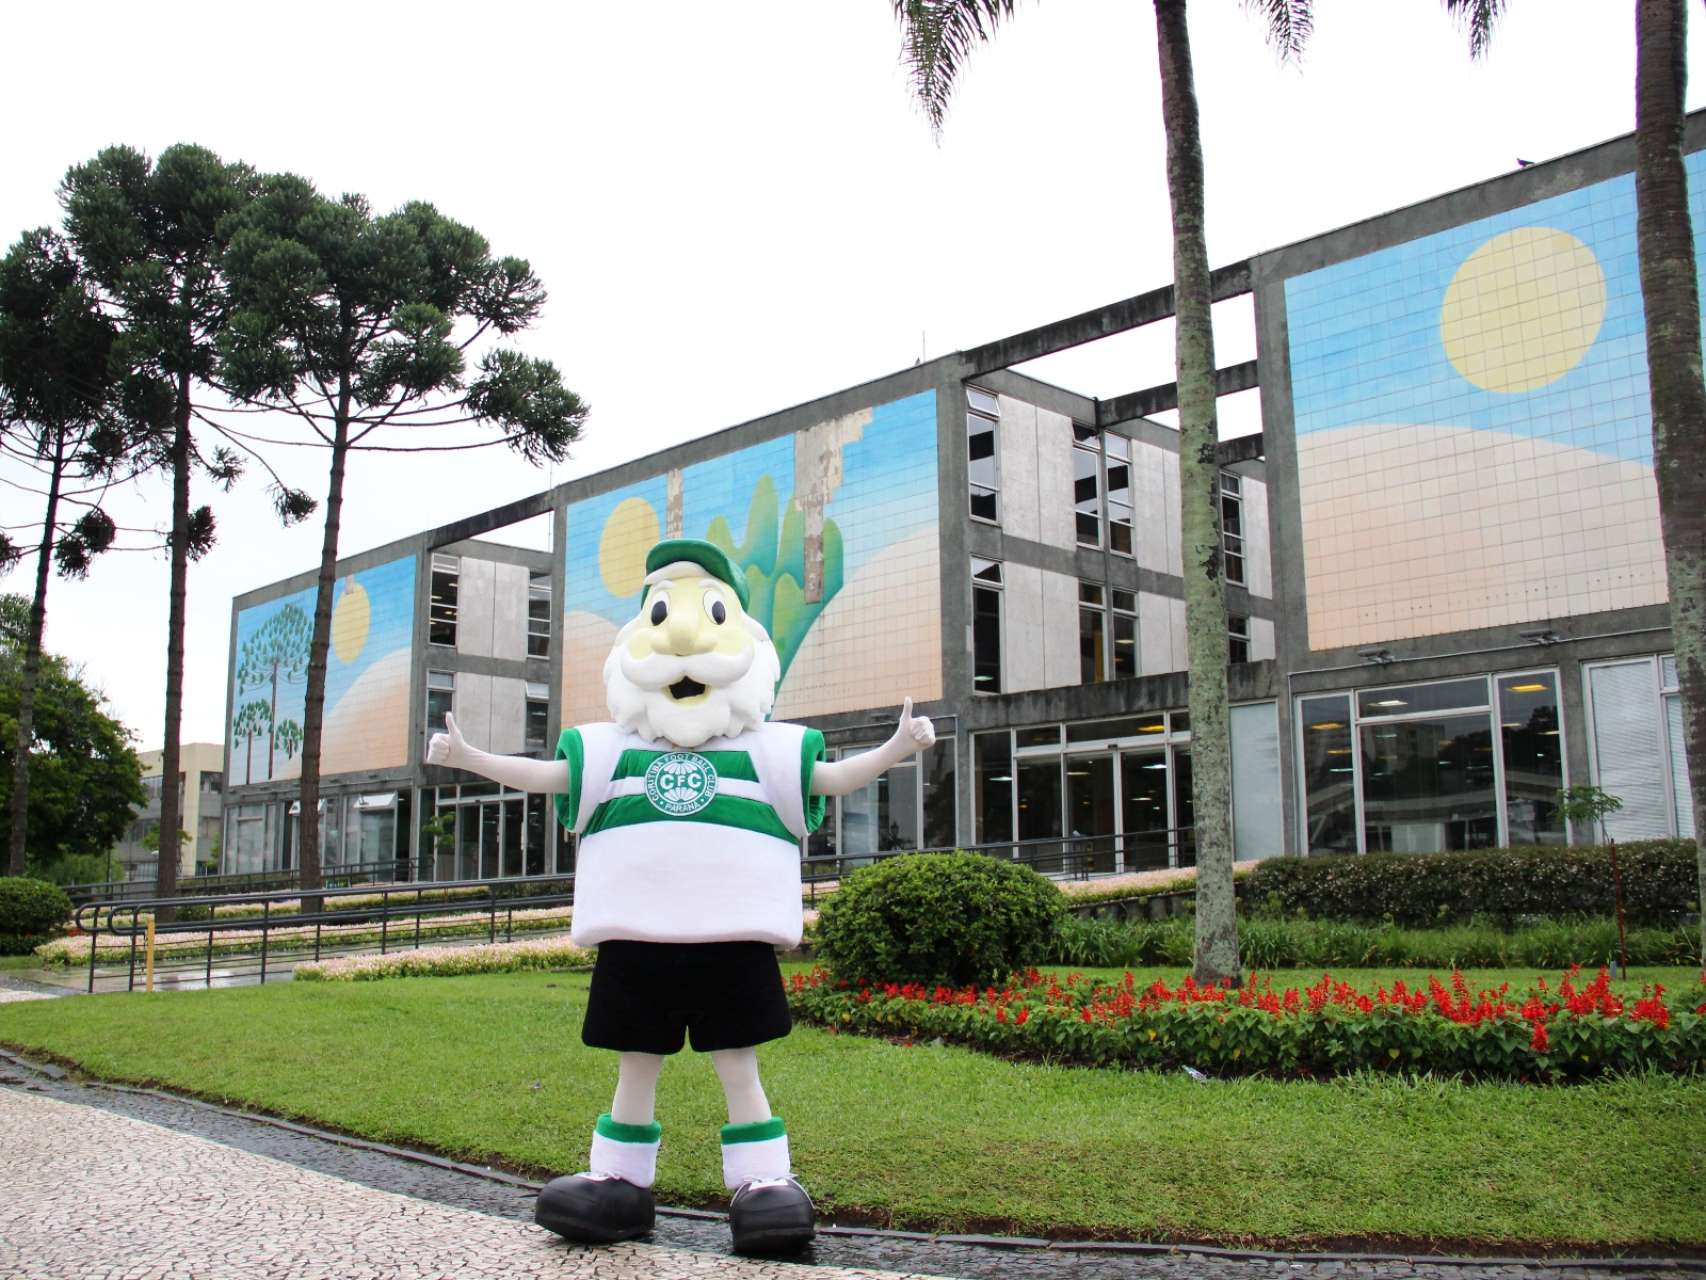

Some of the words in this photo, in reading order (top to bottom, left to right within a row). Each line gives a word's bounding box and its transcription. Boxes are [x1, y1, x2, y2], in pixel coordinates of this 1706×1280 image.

[647, 761, 664, 802] CORITIBA
[704, 774, 716, 798] CLUB
[660, 772, 702, 790] CFC
